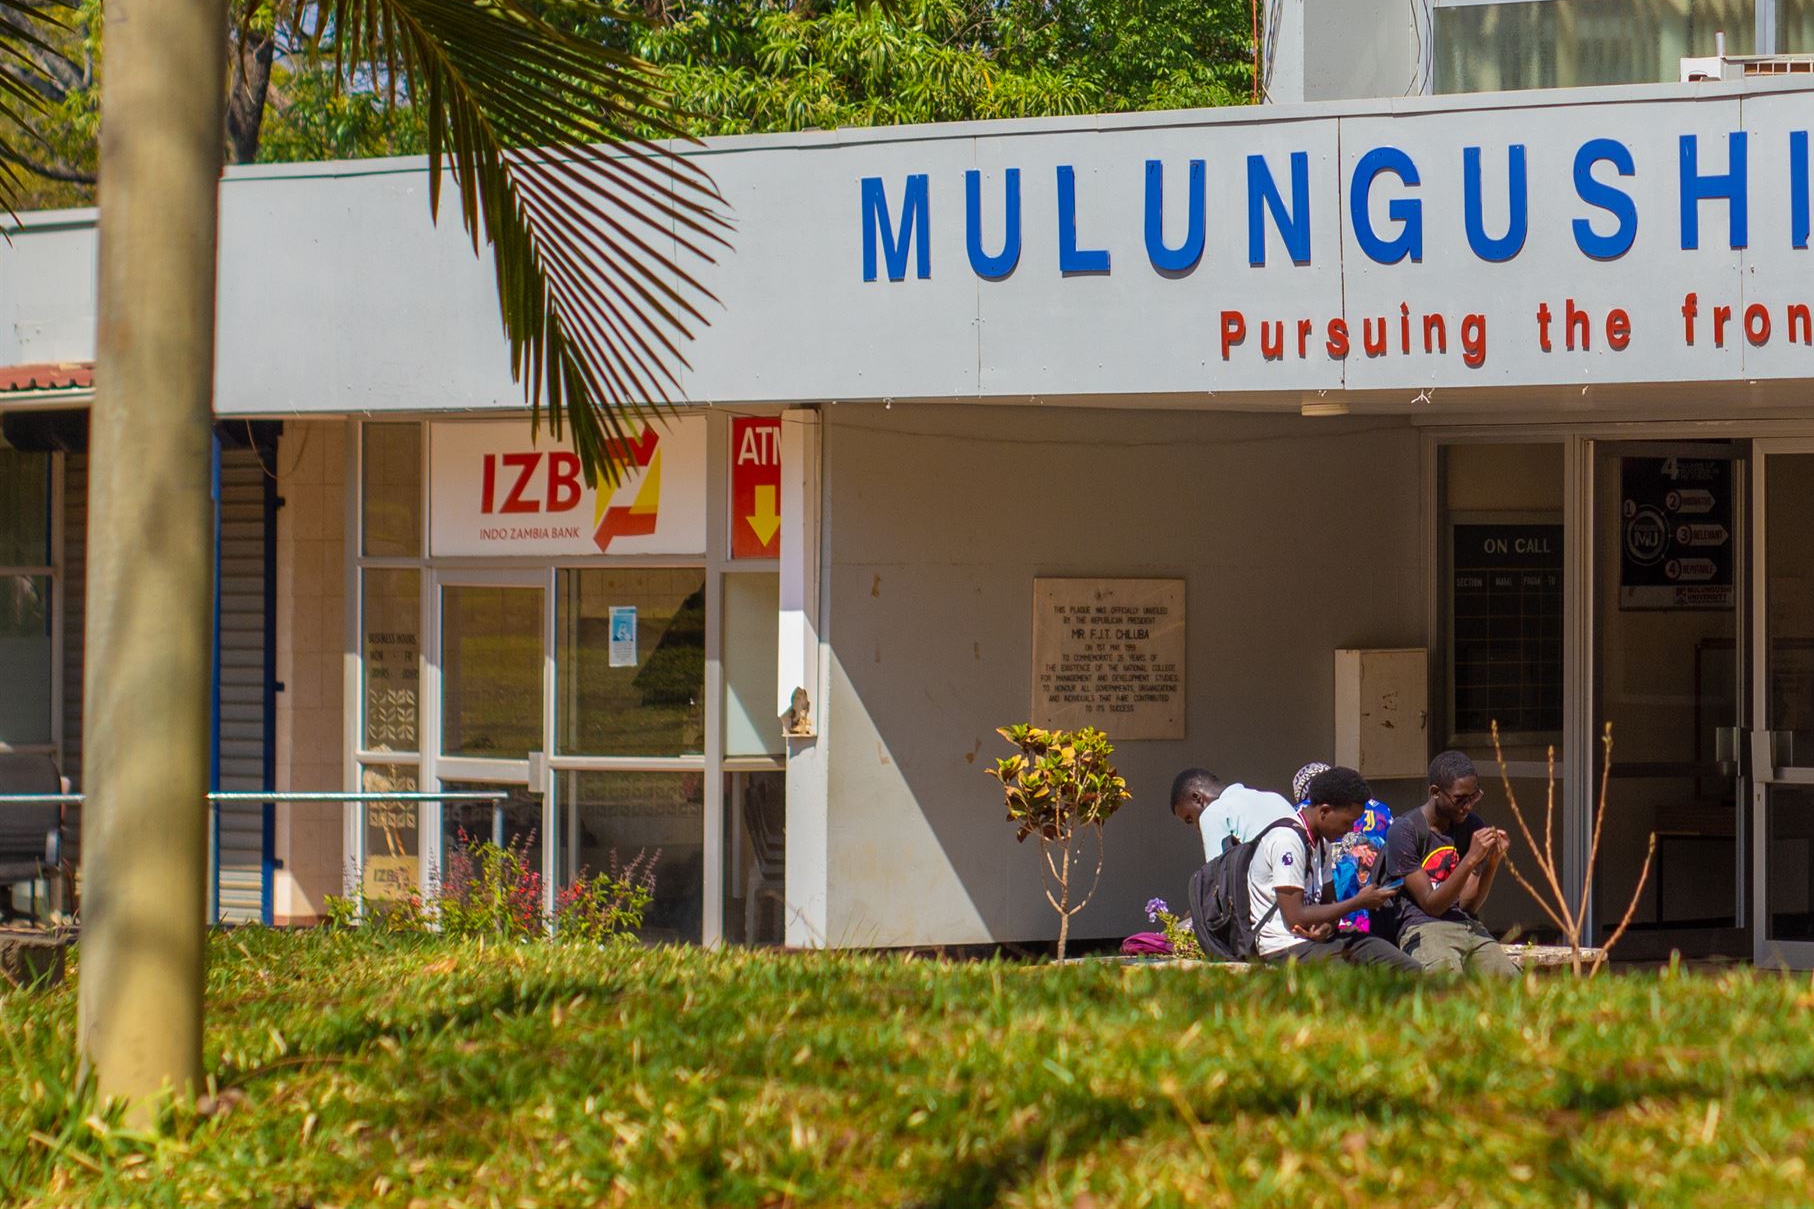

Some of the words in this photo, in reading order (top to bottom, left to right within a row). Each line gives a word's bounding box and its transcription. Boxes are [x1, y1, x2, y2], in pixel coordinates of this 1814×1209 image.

[861, 130, 1810, 283] MULUNGUSHI
[1221, 301, 1487, 367] Pursuing
[1537, 296, 1631, 350] the
[1661, 459, 1678, 480] 4
[481, 451, 582, 514] IZB
[480, 528, 507, 540] INDO
[510, 527, 549, 539] ZAMBIA
[552, 526, 580, 538] BANK
[1484, 538, 1508, 554] ON
[1515, 538, 1551, 553] CALL
[1116, 629, 1149, 640] CHILUBA
